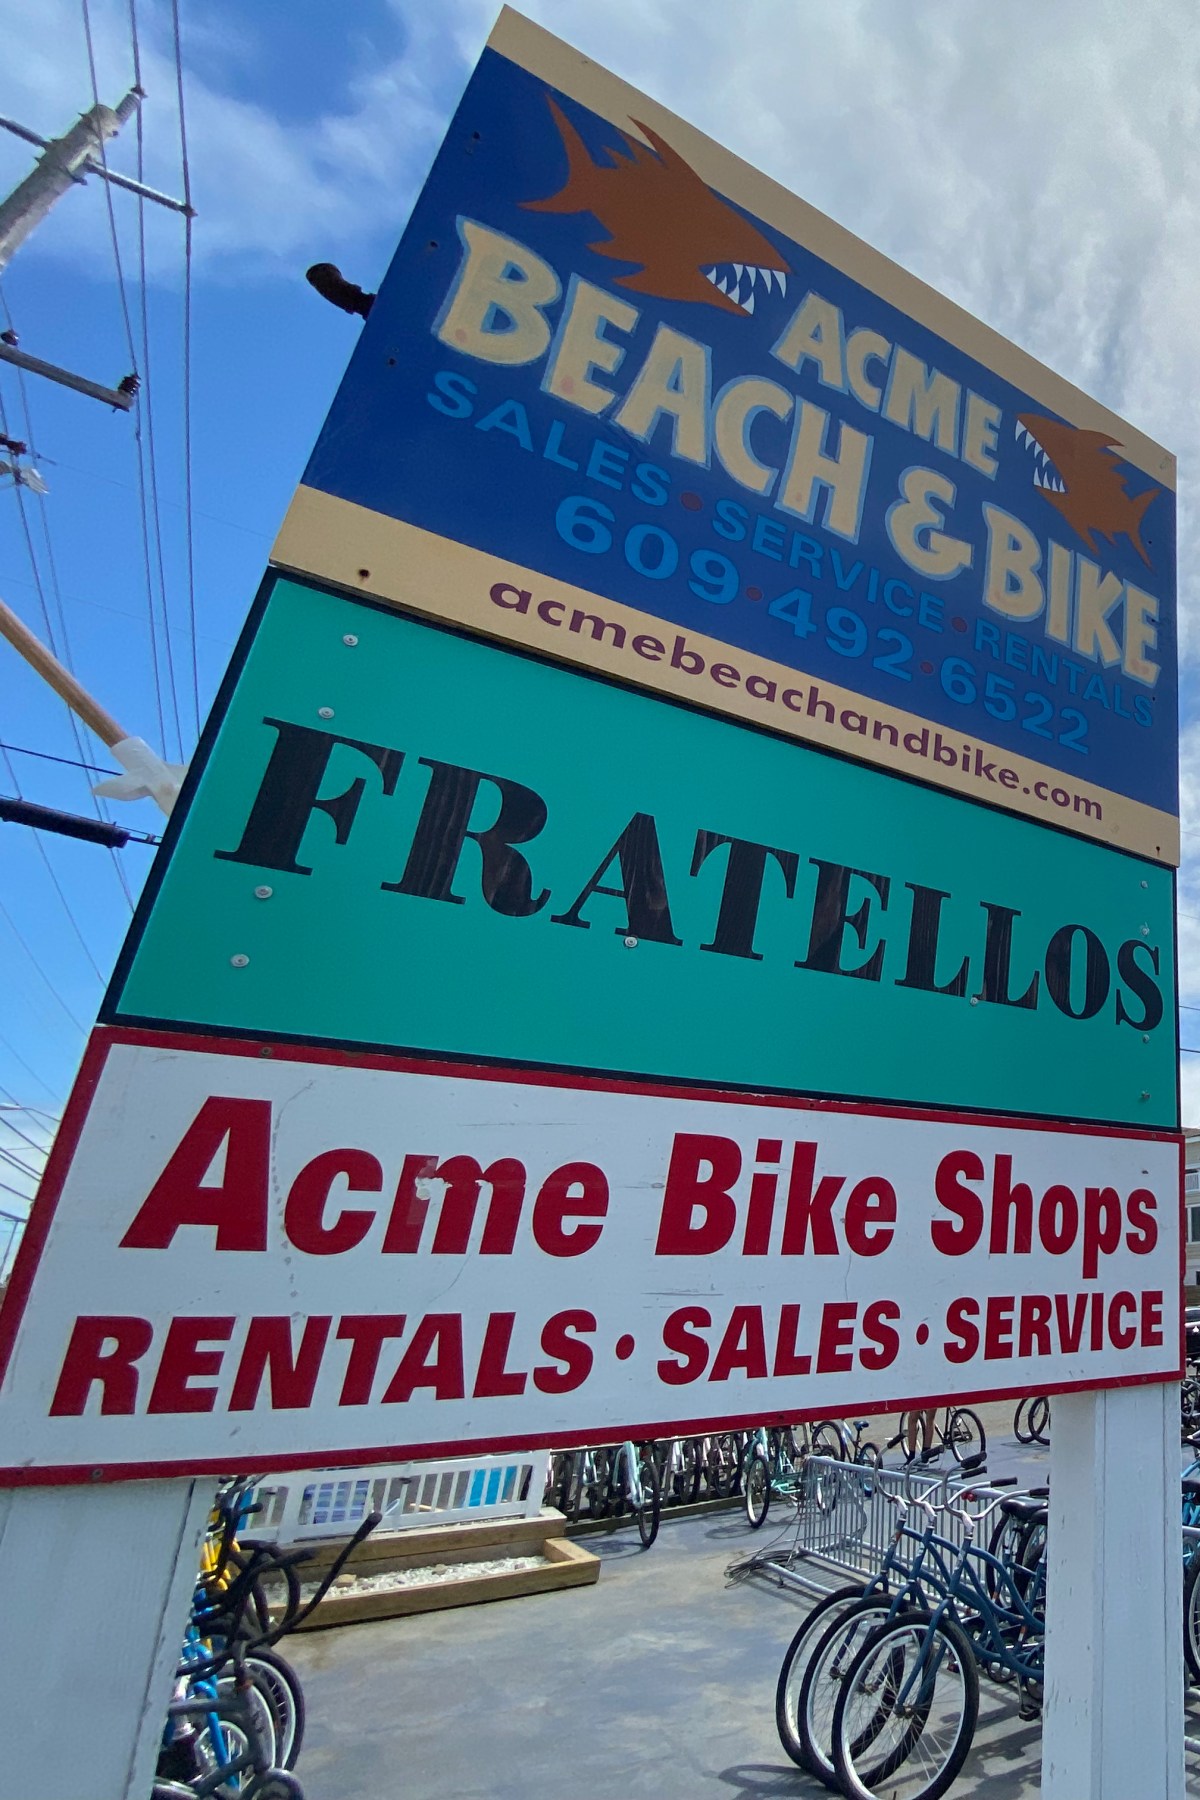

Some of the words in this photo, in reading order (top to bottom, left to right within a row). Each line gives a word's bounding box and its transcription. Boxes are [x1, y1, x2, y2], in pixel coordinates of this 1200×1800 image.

[432, 215, 874, 546] BEACH
[887, 466, 972, 582] &
[981, 501, 1160, 688] BIKE
[770, 290, 1001, 480] ACME
[426, 369, 672, 508] SALES
[712, 501, 945, 633] SERVICE
[974, 616, 1154, 729] RENTALS
[489, 581, 1104, 822] acmebeachandbike.com
[213, 717, 1163, 1033] FRATELLOS
[118, 1096, 610, 1258] Acme
[653, 1131, 897, 1257] Bike
[930, 1150, 1159, 1279] Shops
[47, 1307, 596, 1416] RENTALS
[656, 1298, 898, 1384] SALES
[942, 1290, 1163, 1364] SERVICE
